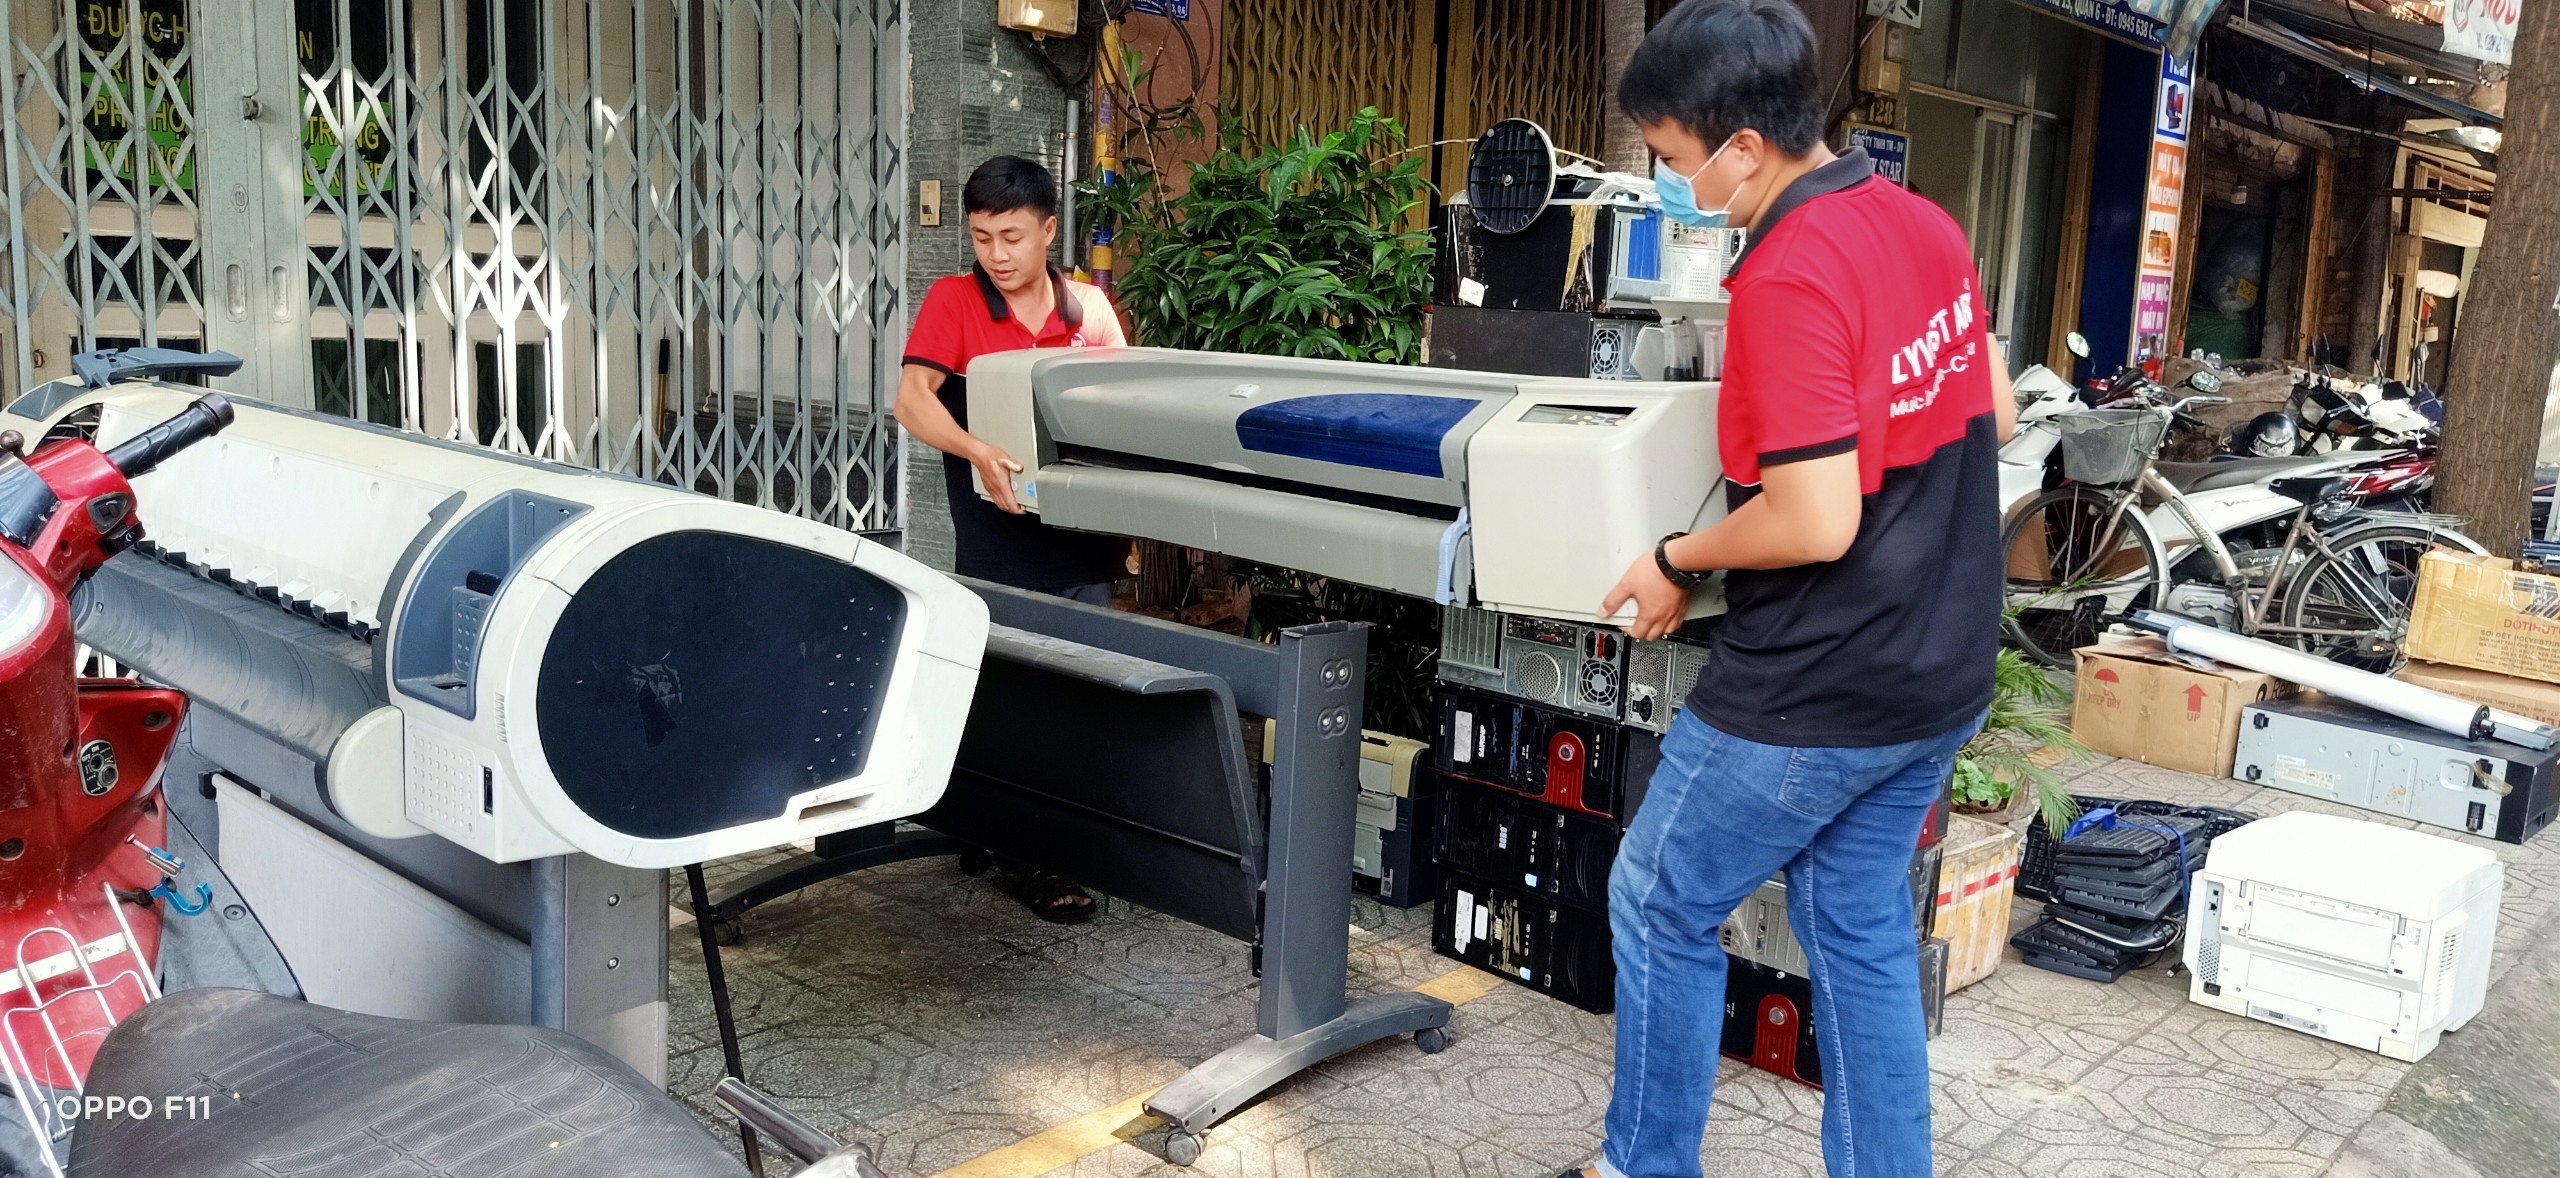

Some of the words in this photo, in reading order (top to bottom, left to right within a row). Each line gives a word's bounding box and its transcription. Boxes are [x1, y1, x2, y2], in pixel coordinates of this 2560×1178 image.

[2117, 11, 2135, 33] 0945
[2135, 18, 2148, 37] 638
[1868, 100, 1894, 125] 128
[1879, 159, 1902, 182] STAR
[2106, 698, 2120, 709] DRY
[2186, 712, 2200, 722] UP
